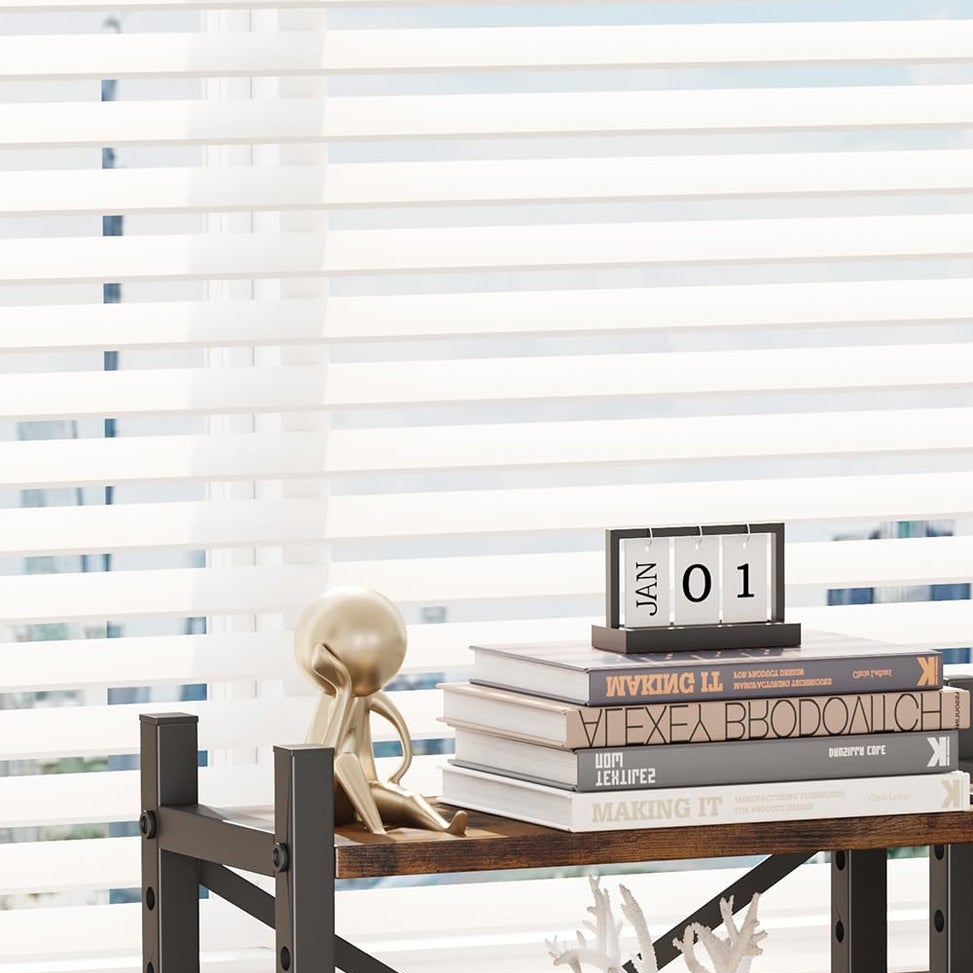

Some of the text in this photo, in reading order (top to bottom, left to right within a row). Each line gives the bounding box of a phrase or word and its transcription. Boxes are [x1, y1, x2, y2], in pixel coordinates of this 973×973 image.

[635, 562, 657, 616] JAN
[591, 796, 723, 823] MAKING IT
